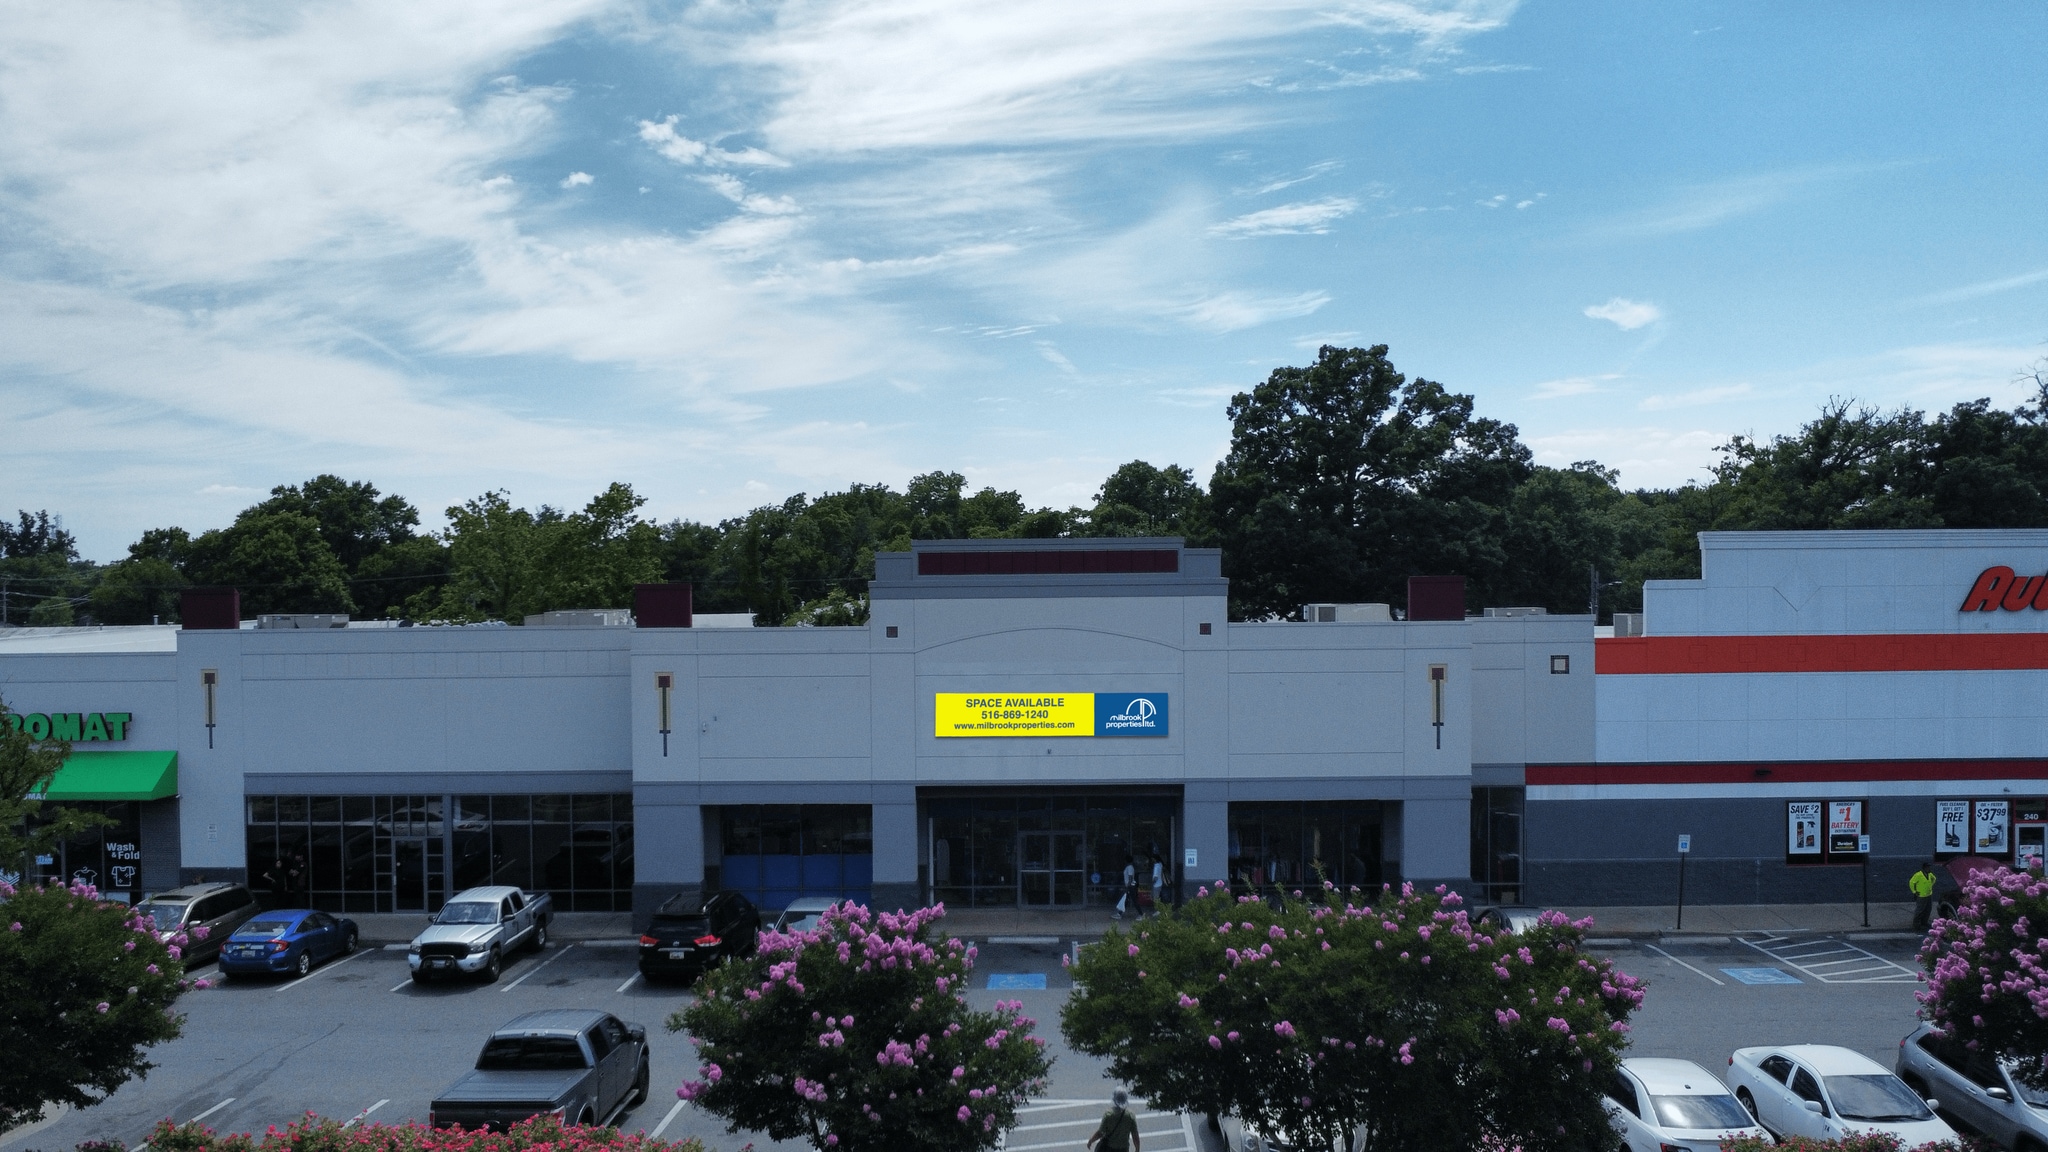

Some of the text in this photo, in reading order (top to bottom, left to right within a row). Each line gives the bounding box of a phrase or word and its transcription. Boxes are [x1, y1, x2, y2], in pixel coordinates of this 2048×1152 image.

[965, 698, 1065, 708] SPACE AVAILABLE
[981, 710, 1049, 720] 516-869-1240
[1110, 713, 1141, 721] milbrook
[954, 721, 1075, 731] www.milbrookproperties.com
[1790, 804, 1820, 814] SAVE $2
[1839, 807, 1851, 821] #1
[1942, 812, 1964, 822] FREE
[107, 843, 135, 852] Wash
[118, 851, 140, 860] Fold
